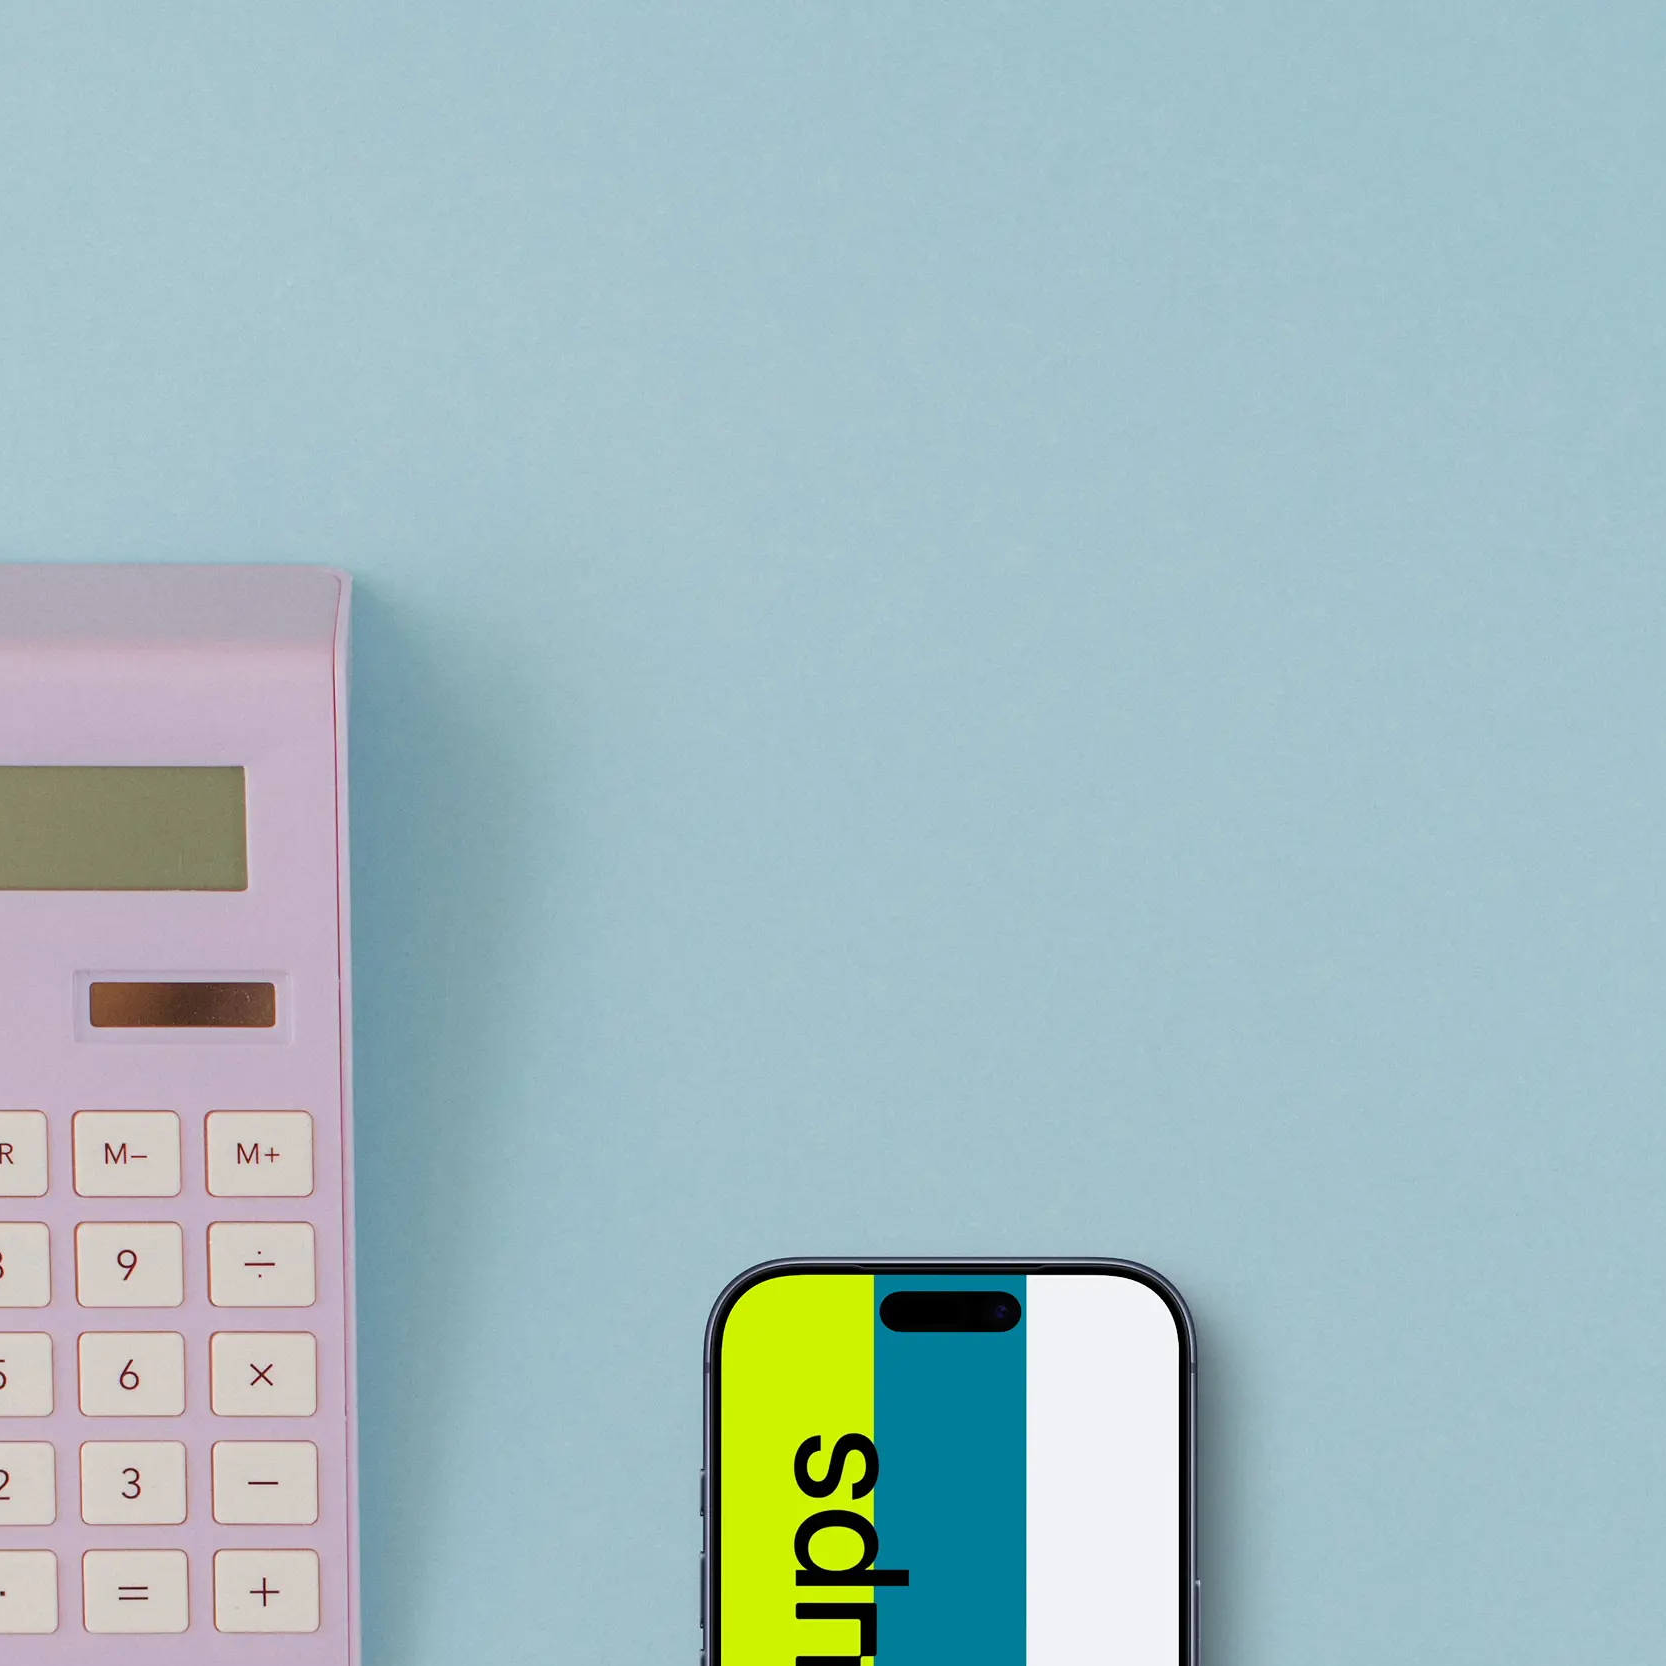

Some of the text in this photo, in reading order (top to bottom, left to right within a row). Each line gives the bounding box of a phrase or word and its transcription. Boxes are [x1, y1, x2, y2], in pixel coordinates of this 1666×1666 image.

[236, 1142, 281, 1165] M+
[116, 1248, 138, 1282] 9
[118, 1358, 140, 1391] 6
[121, 1467, 142, 1500] 3
